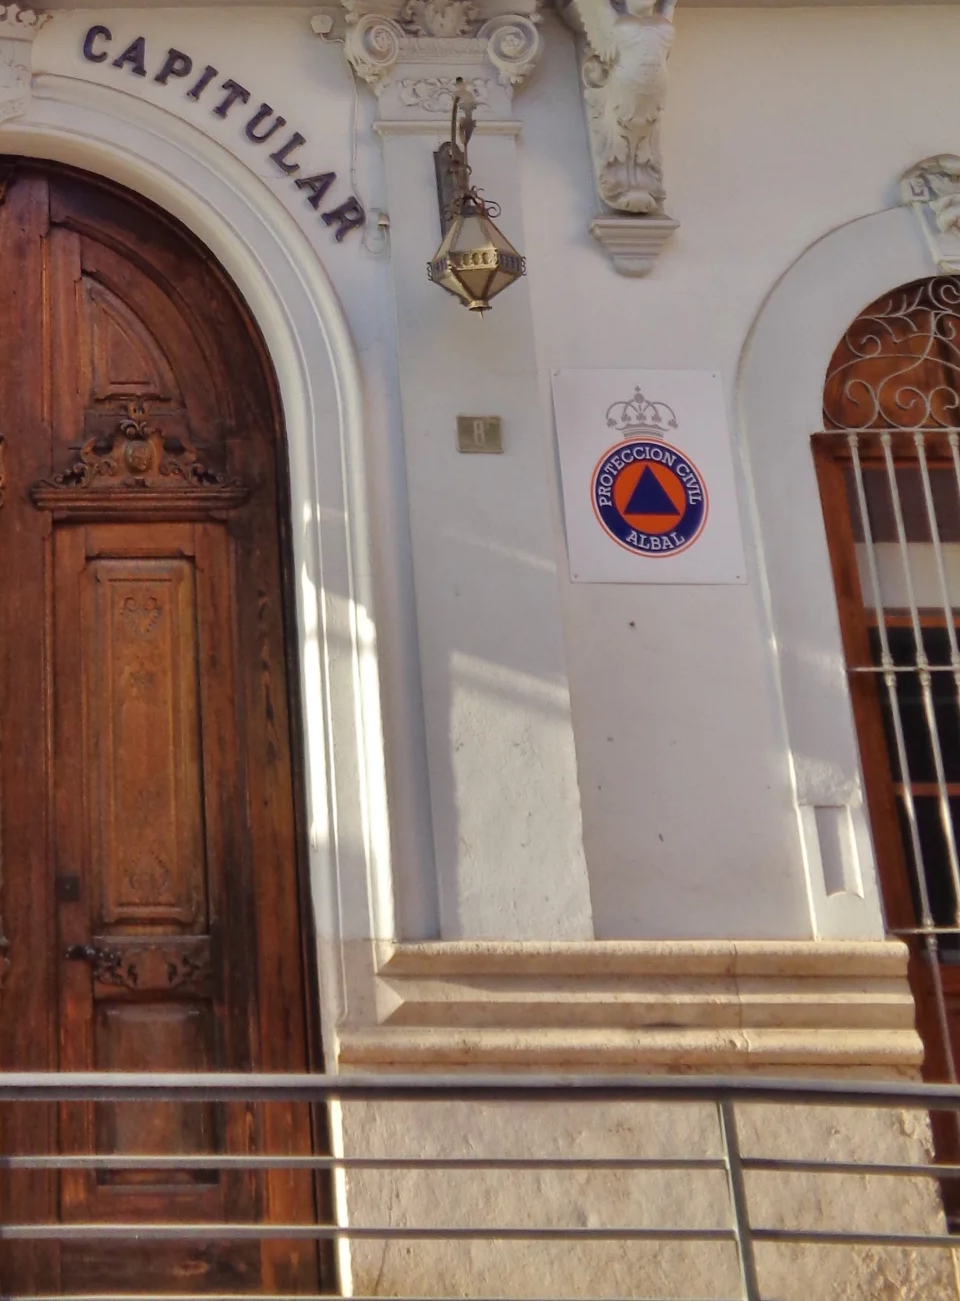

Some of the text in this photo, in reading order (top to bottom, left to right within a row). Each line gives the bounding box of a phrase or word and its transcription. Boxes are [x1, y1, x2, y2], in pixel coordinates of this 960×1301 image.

[82, 24, 367, 243] CAPITULAR
[598, 446, 702, 507] PROTECCION CIVIL
[625, 530, 685, 550] ALBAL
